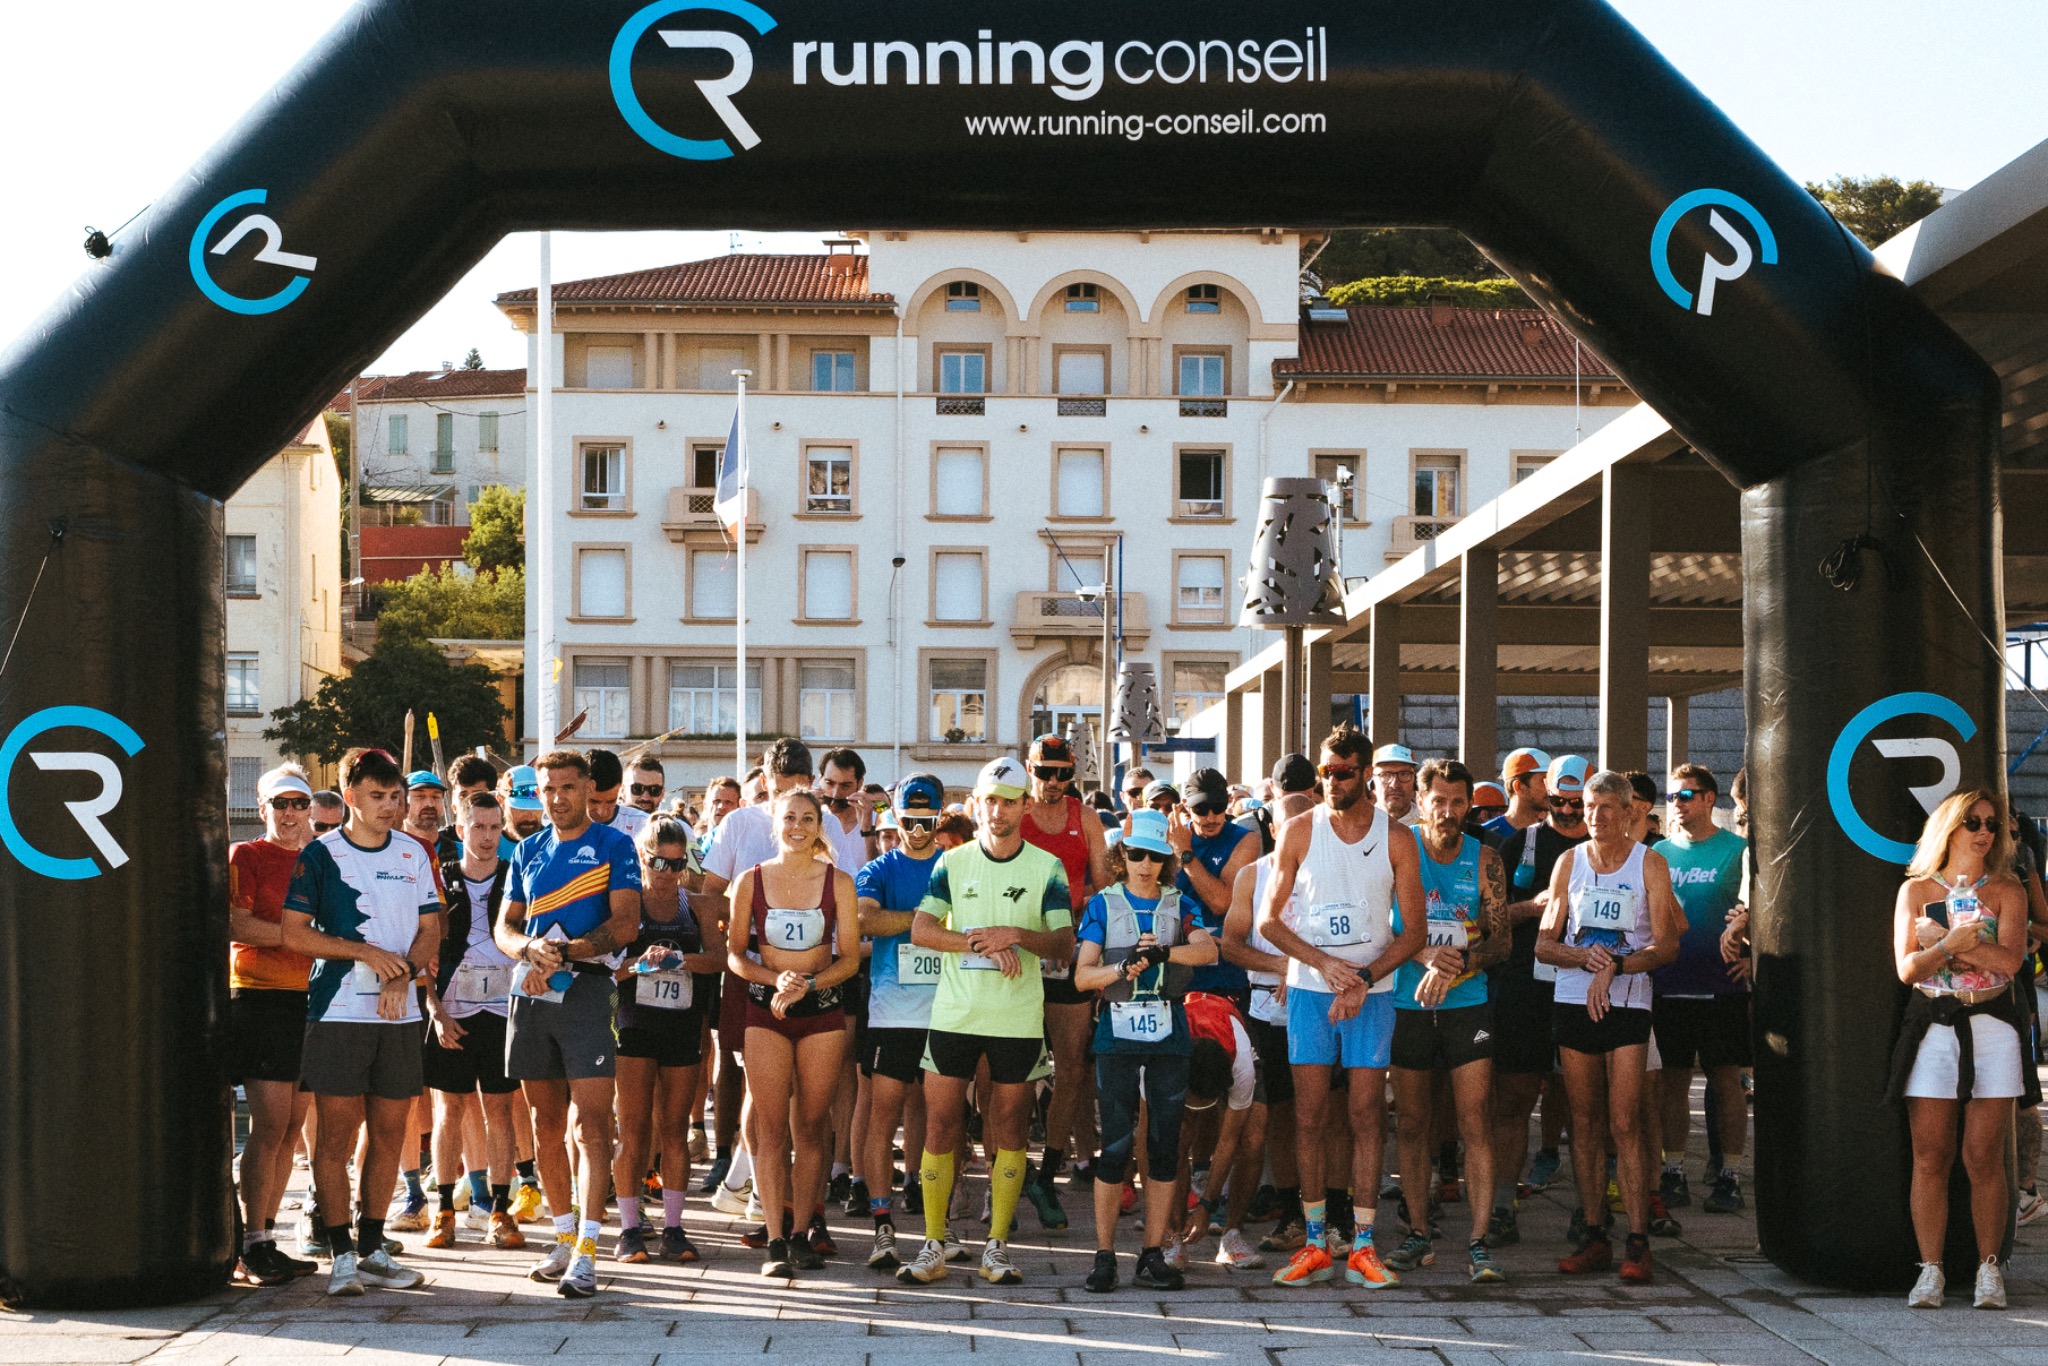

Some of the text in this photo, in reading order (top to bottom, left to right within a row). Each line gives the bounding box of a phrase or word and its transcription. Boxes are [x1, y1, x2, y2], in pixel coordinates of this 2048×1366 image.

[792, 27, 1327, 101] running conseil
[964, 109, 1327, 141] www.running-conseil.com
[1593, 899, 1621, 920] 149
[785, 922, 803, 941] 21
[1329, 915, 1351, 936] 58
[913, 956, 942, 976] 209
[482, 976, 488, 994] 1
[654, 979, 680, 1000] 179
[1128, 1013, 1158, 1034] 145
